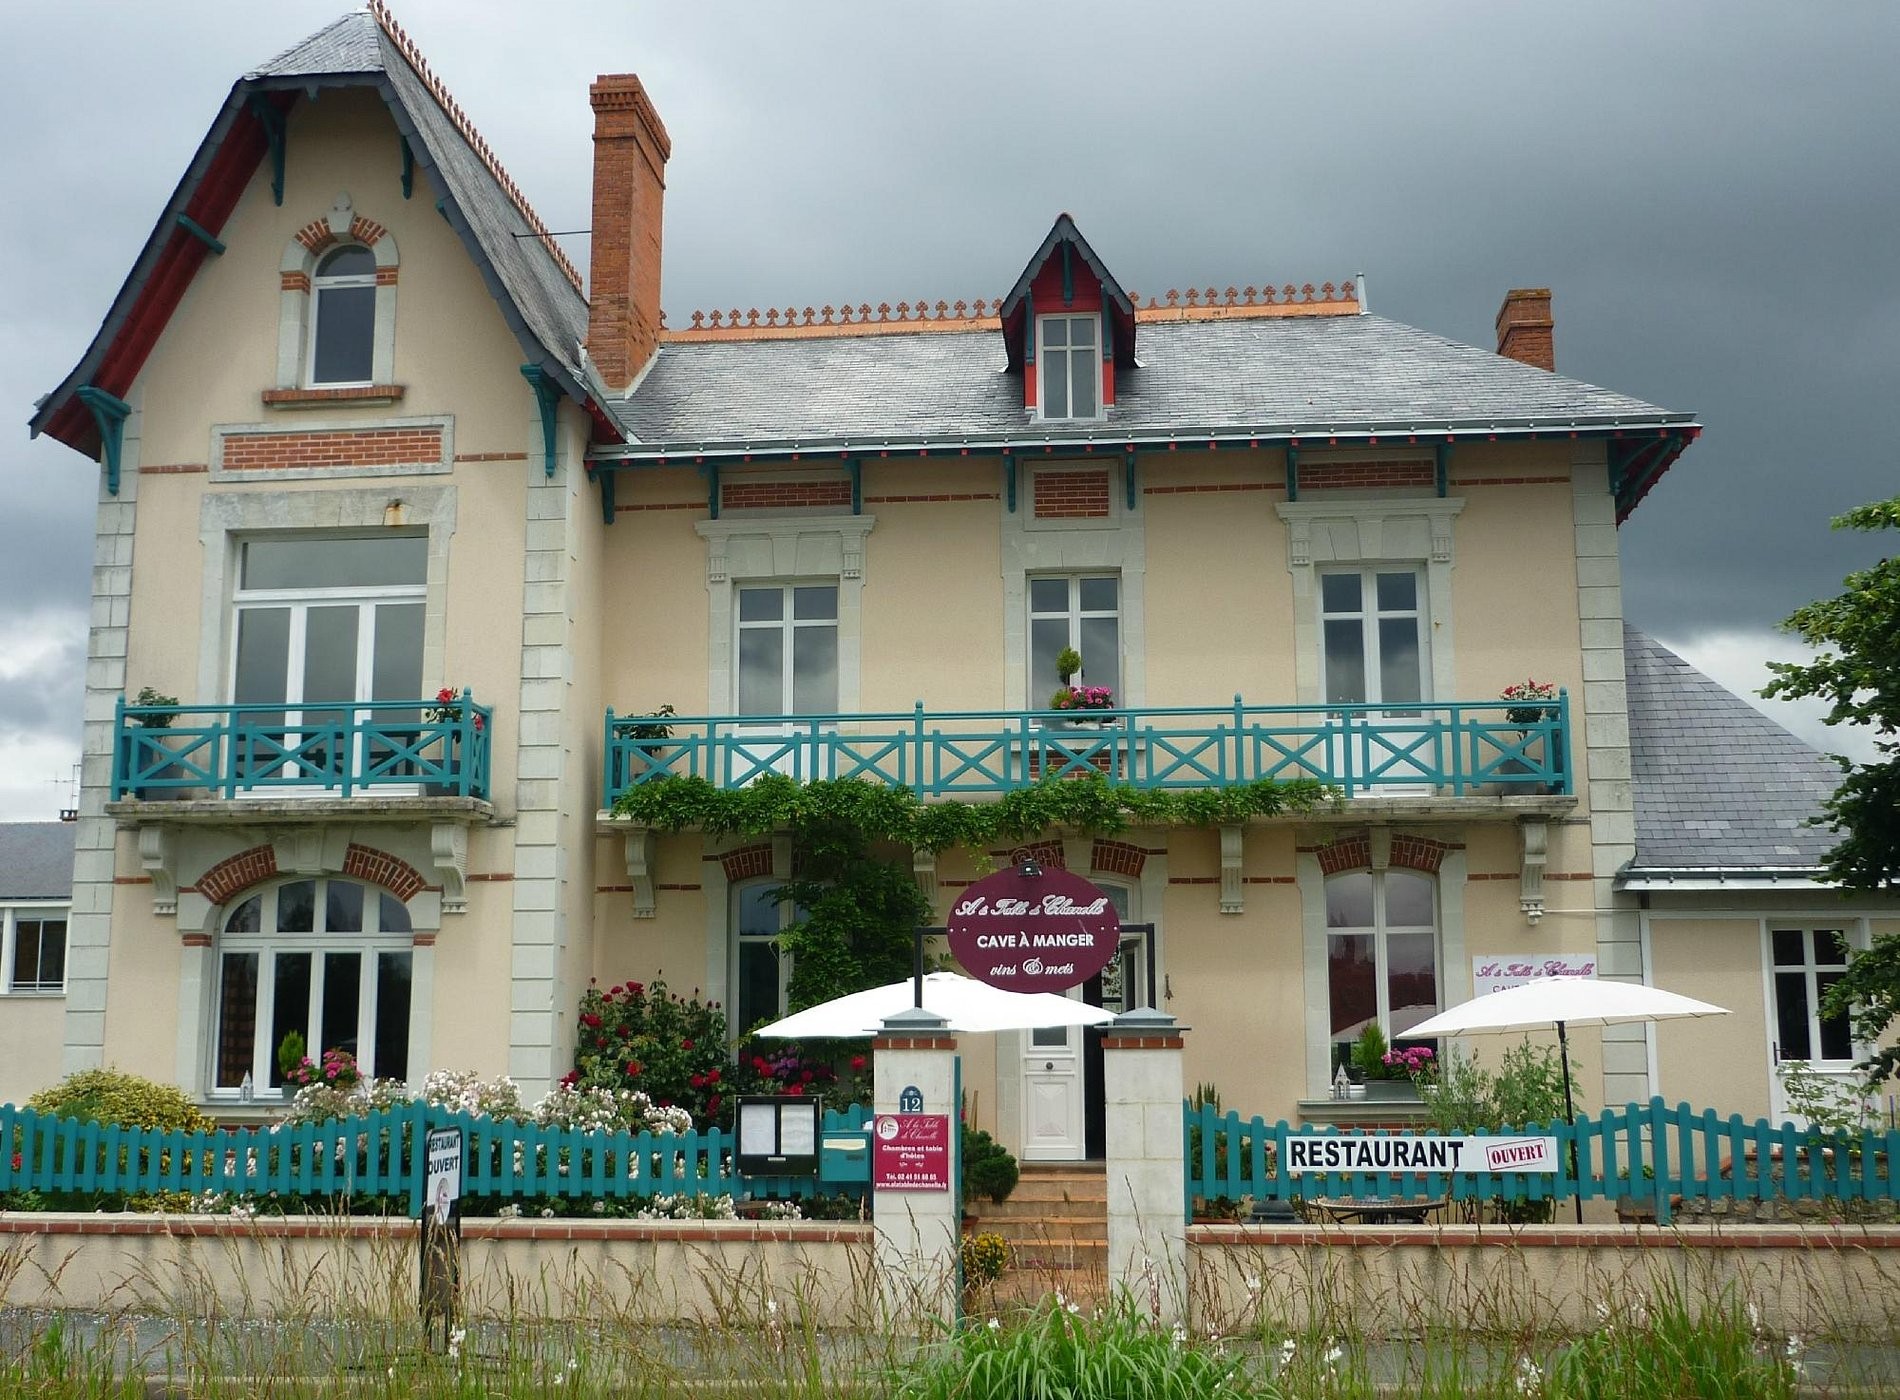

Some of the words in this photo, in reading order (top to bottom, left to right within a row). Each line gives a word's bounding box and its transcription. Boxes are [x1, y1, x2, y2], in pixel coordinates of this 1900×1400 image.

[955, 896, 986, 916] A
[990, 898, 1030, 916] Table
[977, 935, 1016, 948] CAVE
[1018, 931, 1030, 947] À
[1033, 934, 1095, 947] MANGER
[990, 963, 1017, 976] vins
[1044, 963, 1074, 975] mets
[902, 1098, 921, 1112] 12
[926, 1144, 943, 1152] table
[1290, 1140, 1464, 1167] RESTAURANT
[1491, 1144, 1543, 1165] OUVERT
